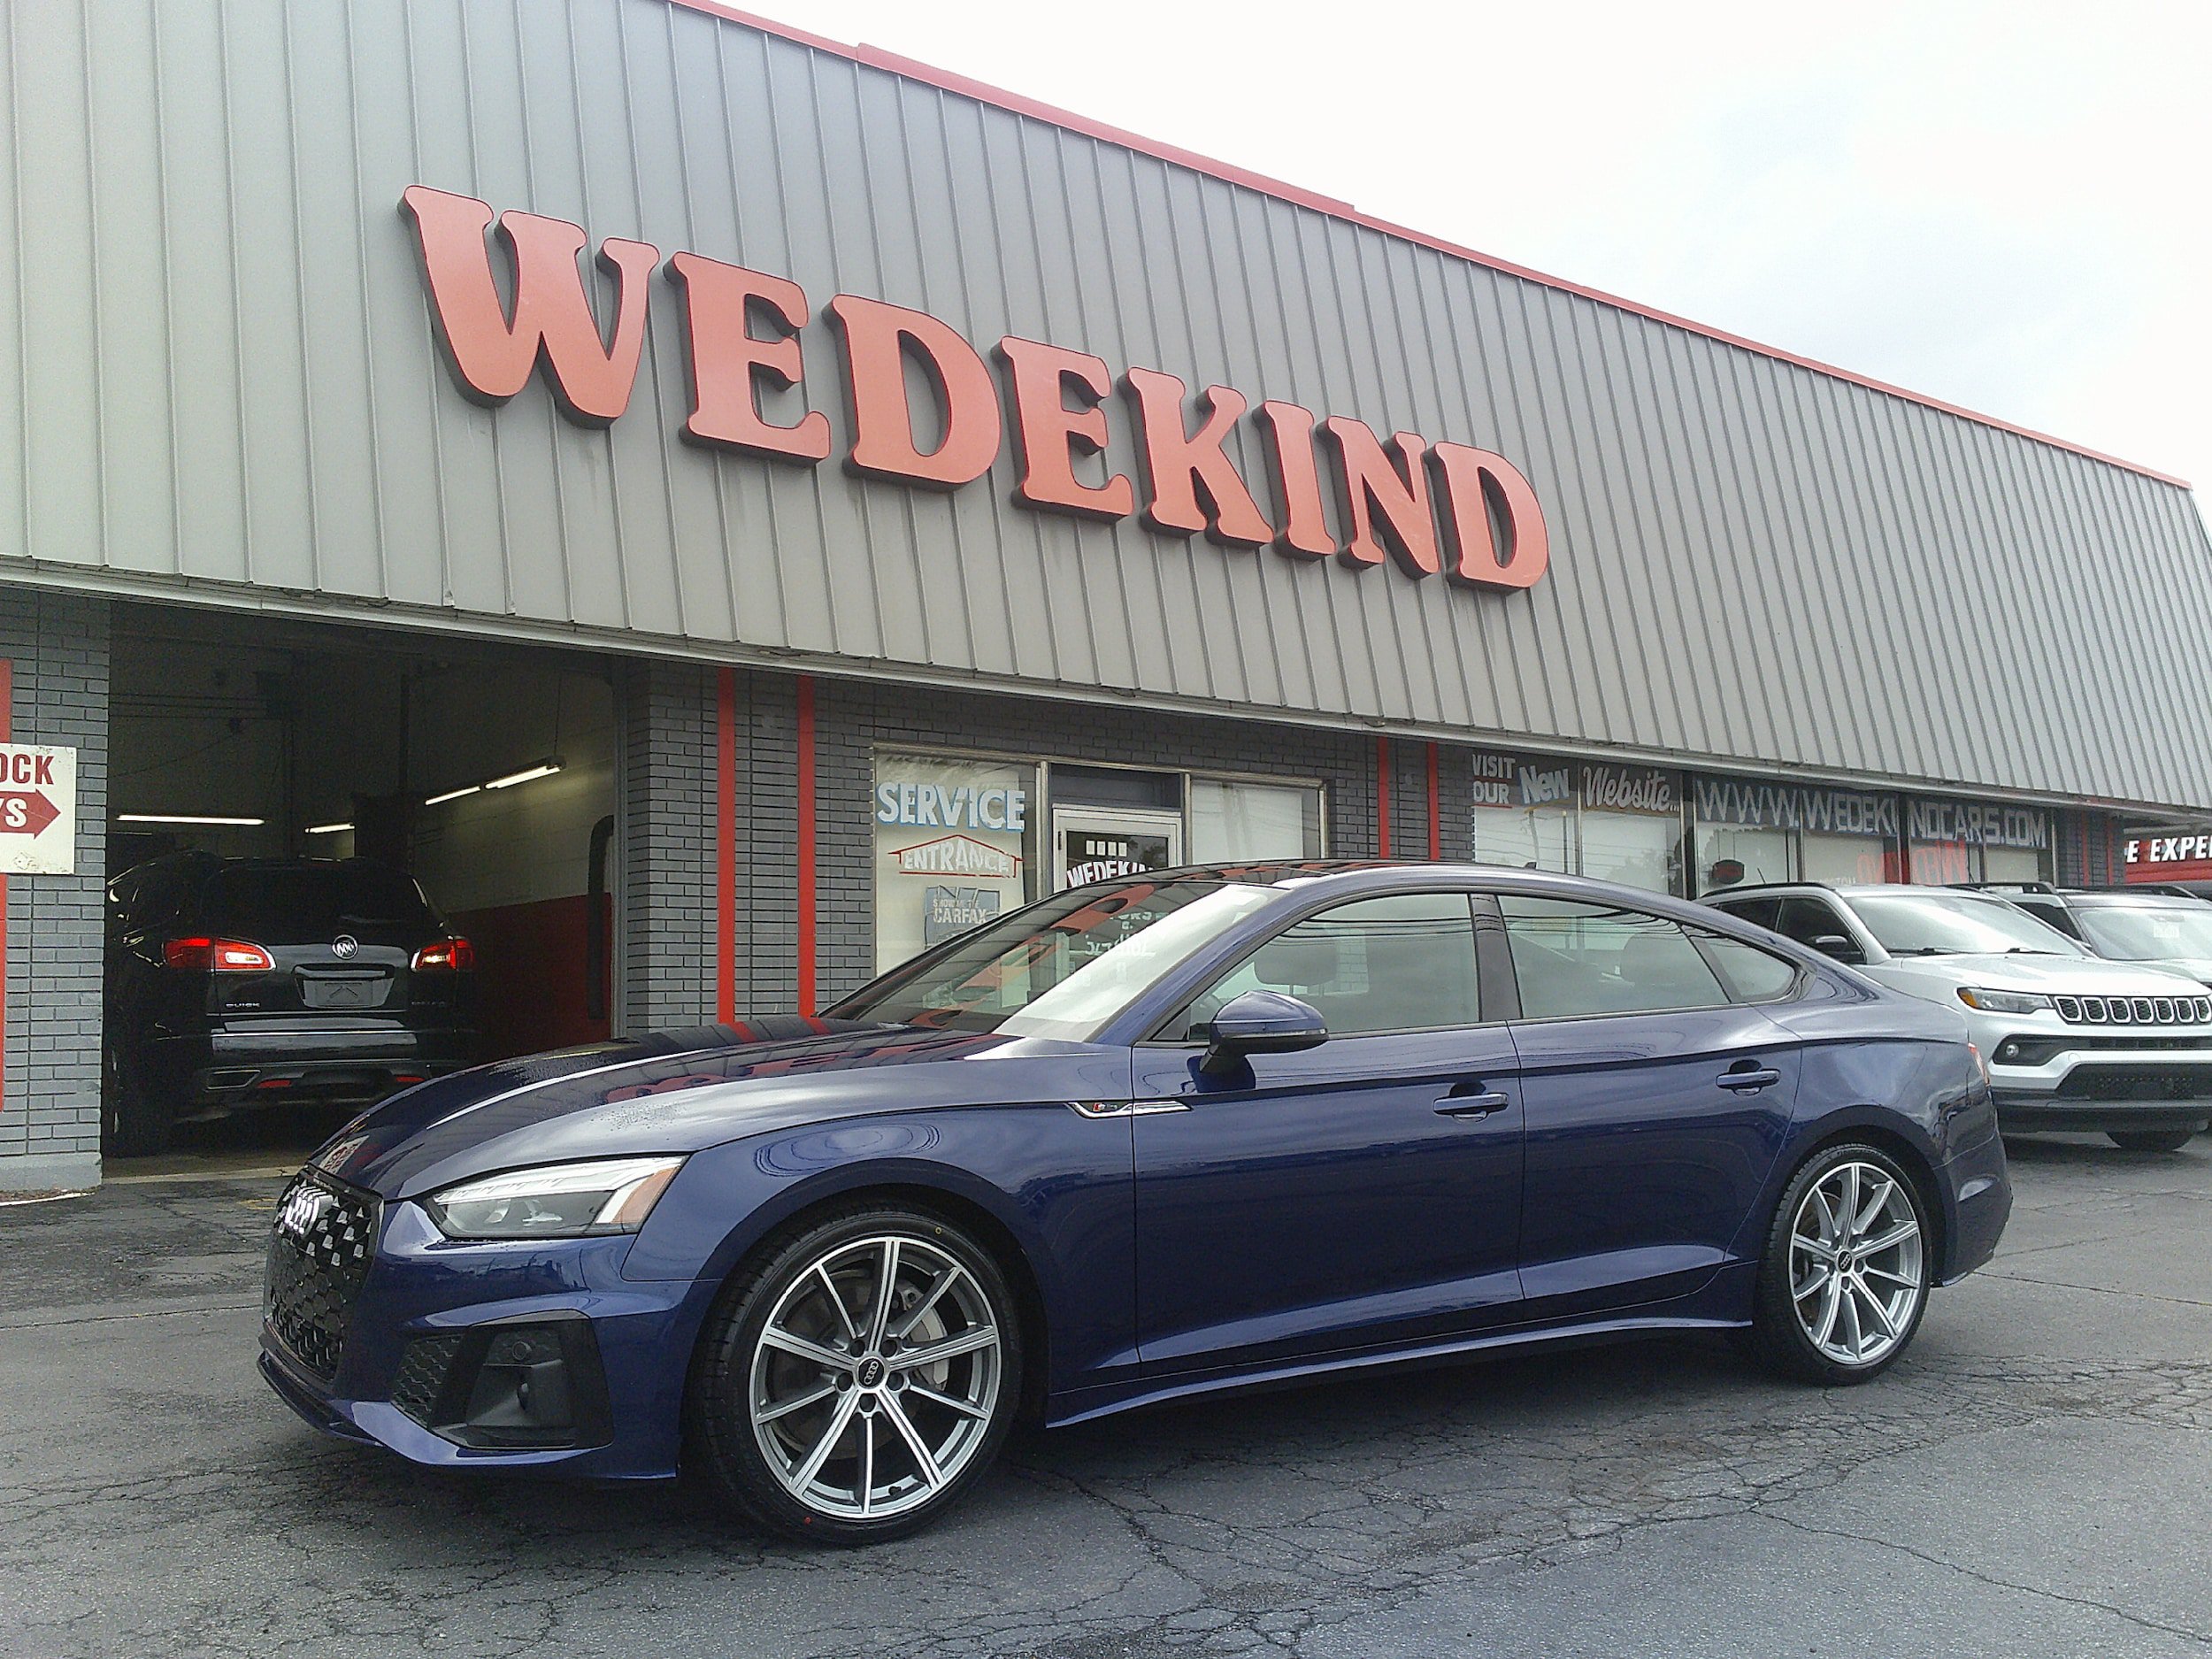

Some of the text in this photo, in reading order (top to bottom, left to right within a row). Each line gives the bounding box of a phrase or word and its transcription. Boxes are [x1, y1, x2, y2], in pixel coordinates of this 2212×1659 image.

[401, 183, 1549, 593] WEDEKIND
[1472, 754, 1516, 779] VISIT
[1472, 780, 1509, 803] OUR
[1518, 765, 1570, 804] New
[876, 782, 1025, 833] SERVICE
[904, 840, 1010, 872] ENTRANCE
[2149, 835, 2212, 863] EXPE
[933, 908, 987, 925] CARFAX
